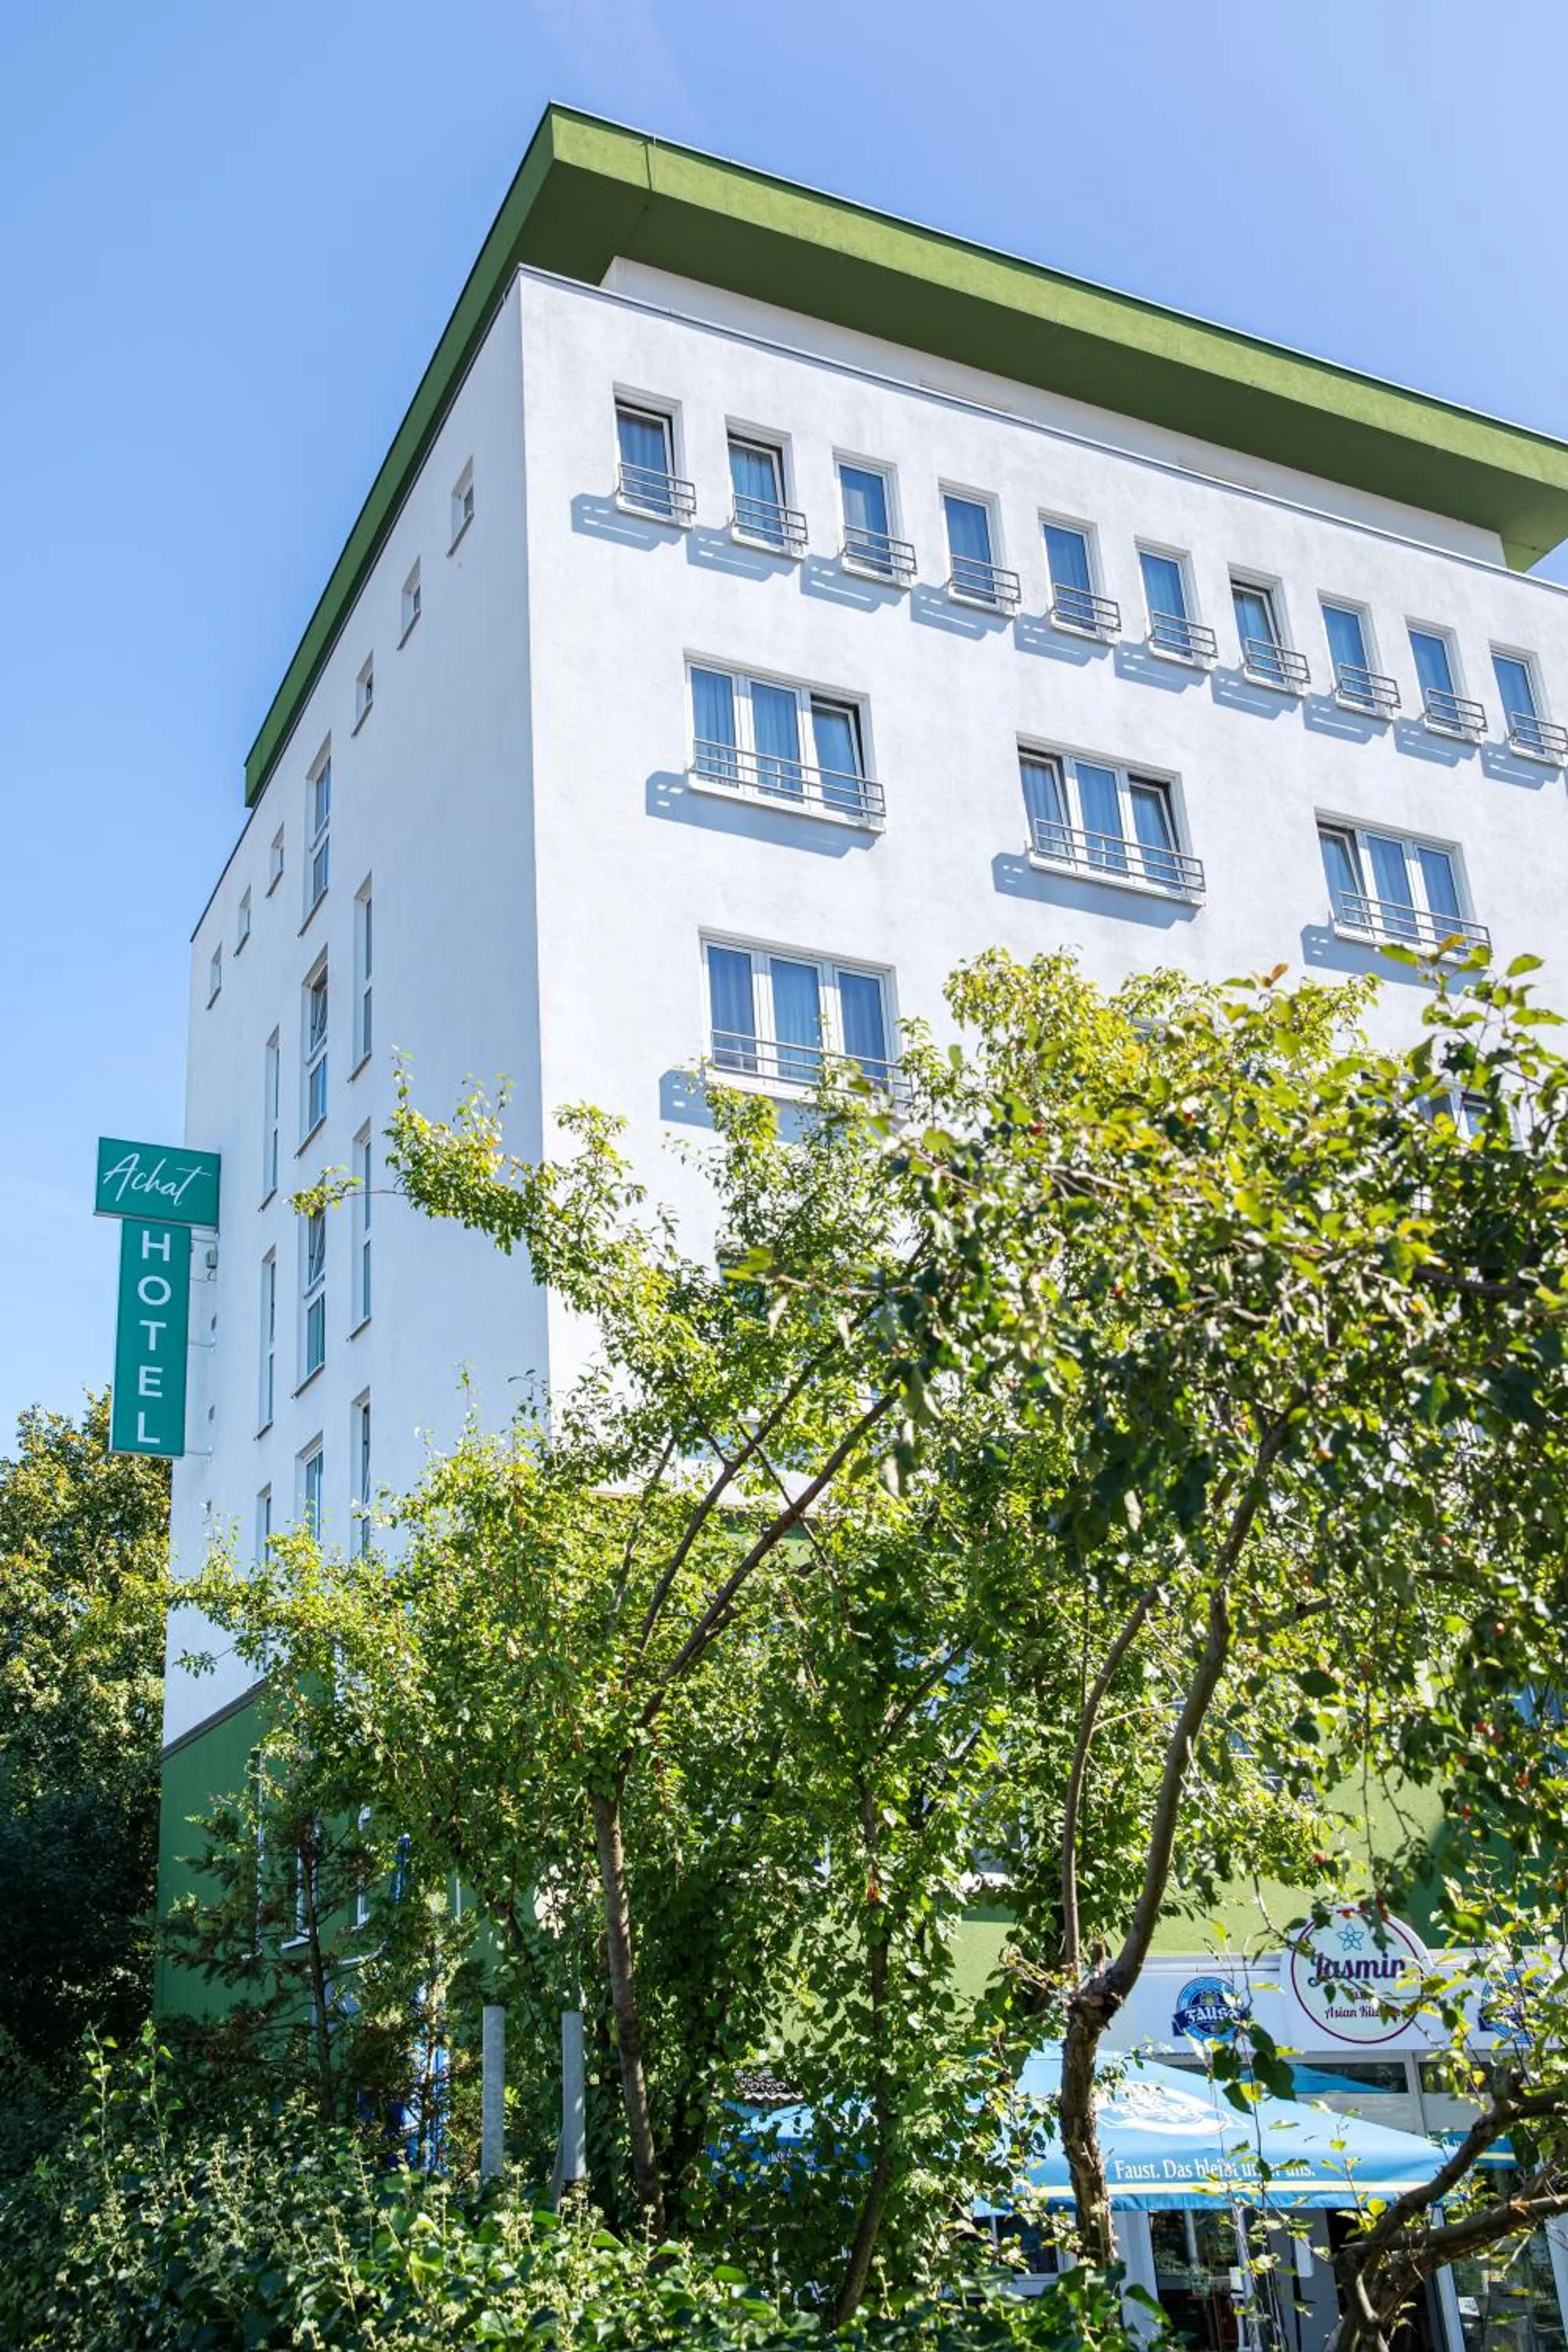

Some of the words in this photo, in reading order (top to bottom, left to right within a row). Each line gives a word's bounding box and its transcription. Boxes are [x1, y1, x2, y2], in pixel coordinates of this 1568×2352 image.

[103, 1152, 212, 1207] Achat
[137, 1229, 172, 1443] HOTEL
[1308, 1952, 1406, 1987] Jasmin
[1325, 2006, 1357, 2020] Asian
[1115, 2160, 1160, 2180] Faust.
[1163, 2159, 1192, 2179] Das
